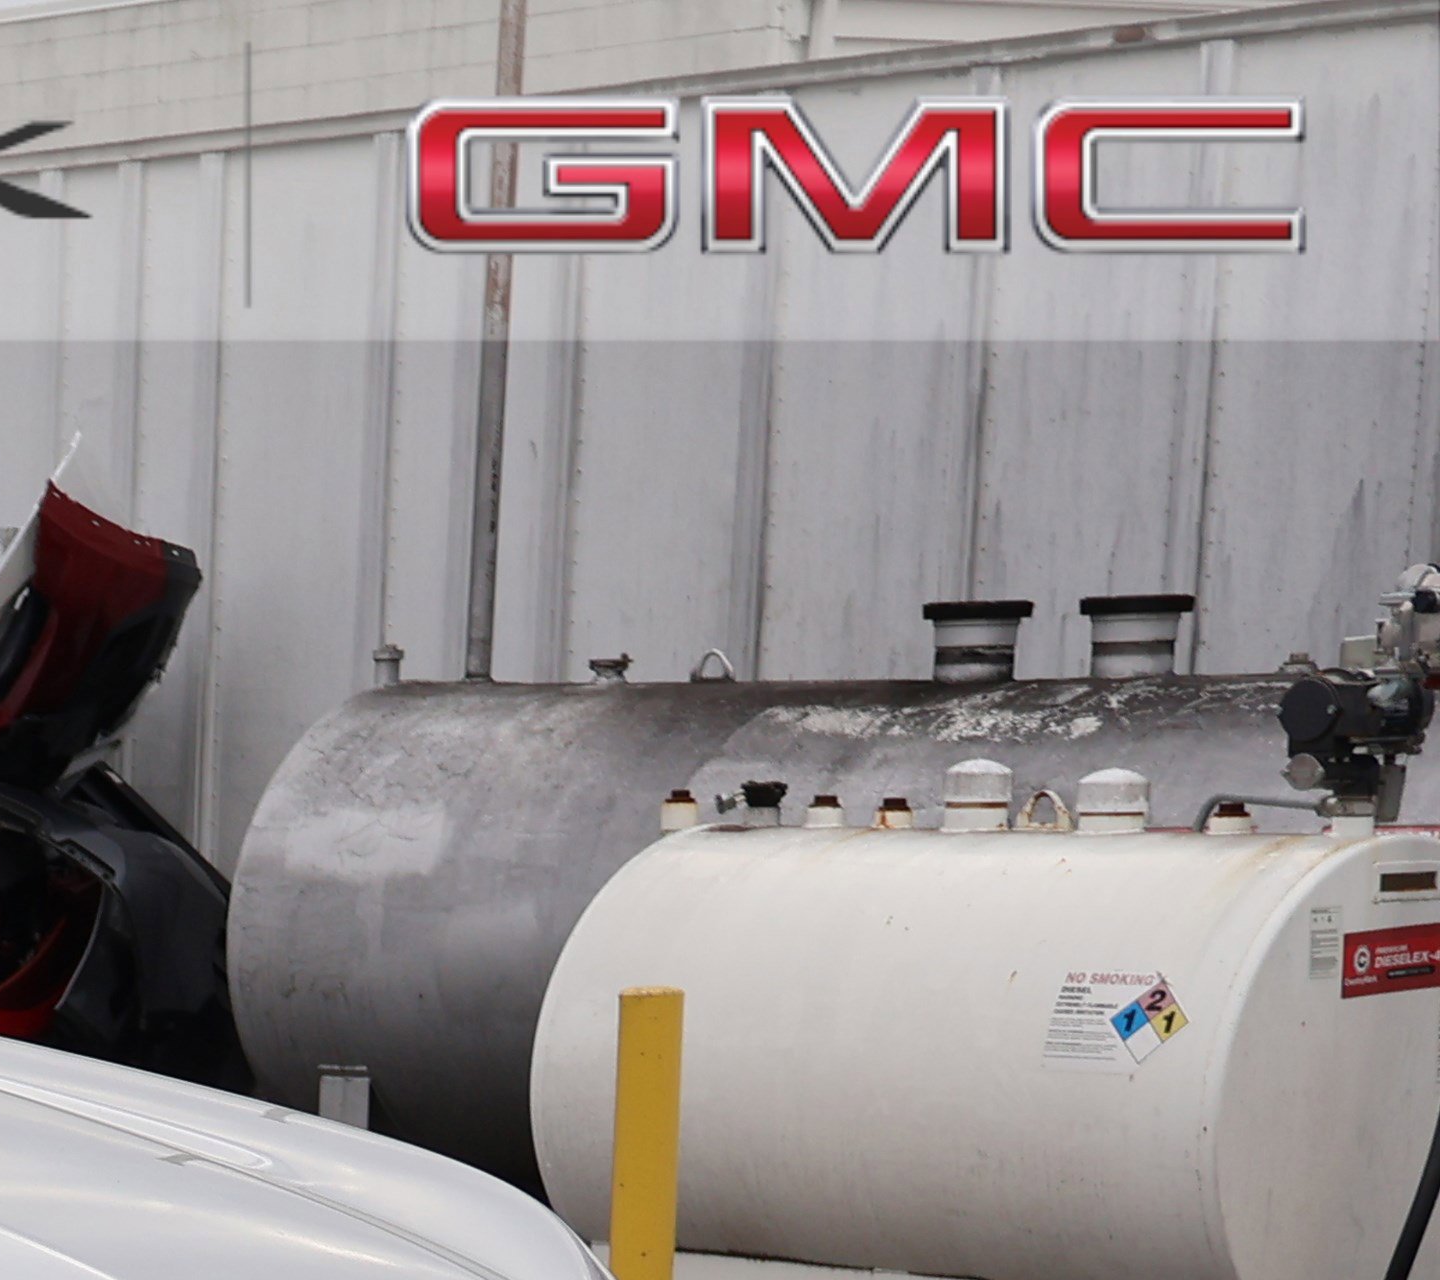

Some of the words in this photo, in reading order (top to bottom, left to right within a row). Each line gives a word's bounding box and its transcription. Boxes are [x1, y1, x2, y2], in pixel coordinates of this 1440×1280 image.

[1064, 971, 1086, 984] NO
[1088, 972, 1156, 986] SMOKING
[1060, 986, 1092, 994] DIESEL
[1144, 990, 1167, 1012] 2
[1123, 1008, 1137, 1032] 1
[1163, 1010, 1176, 1034] 1
